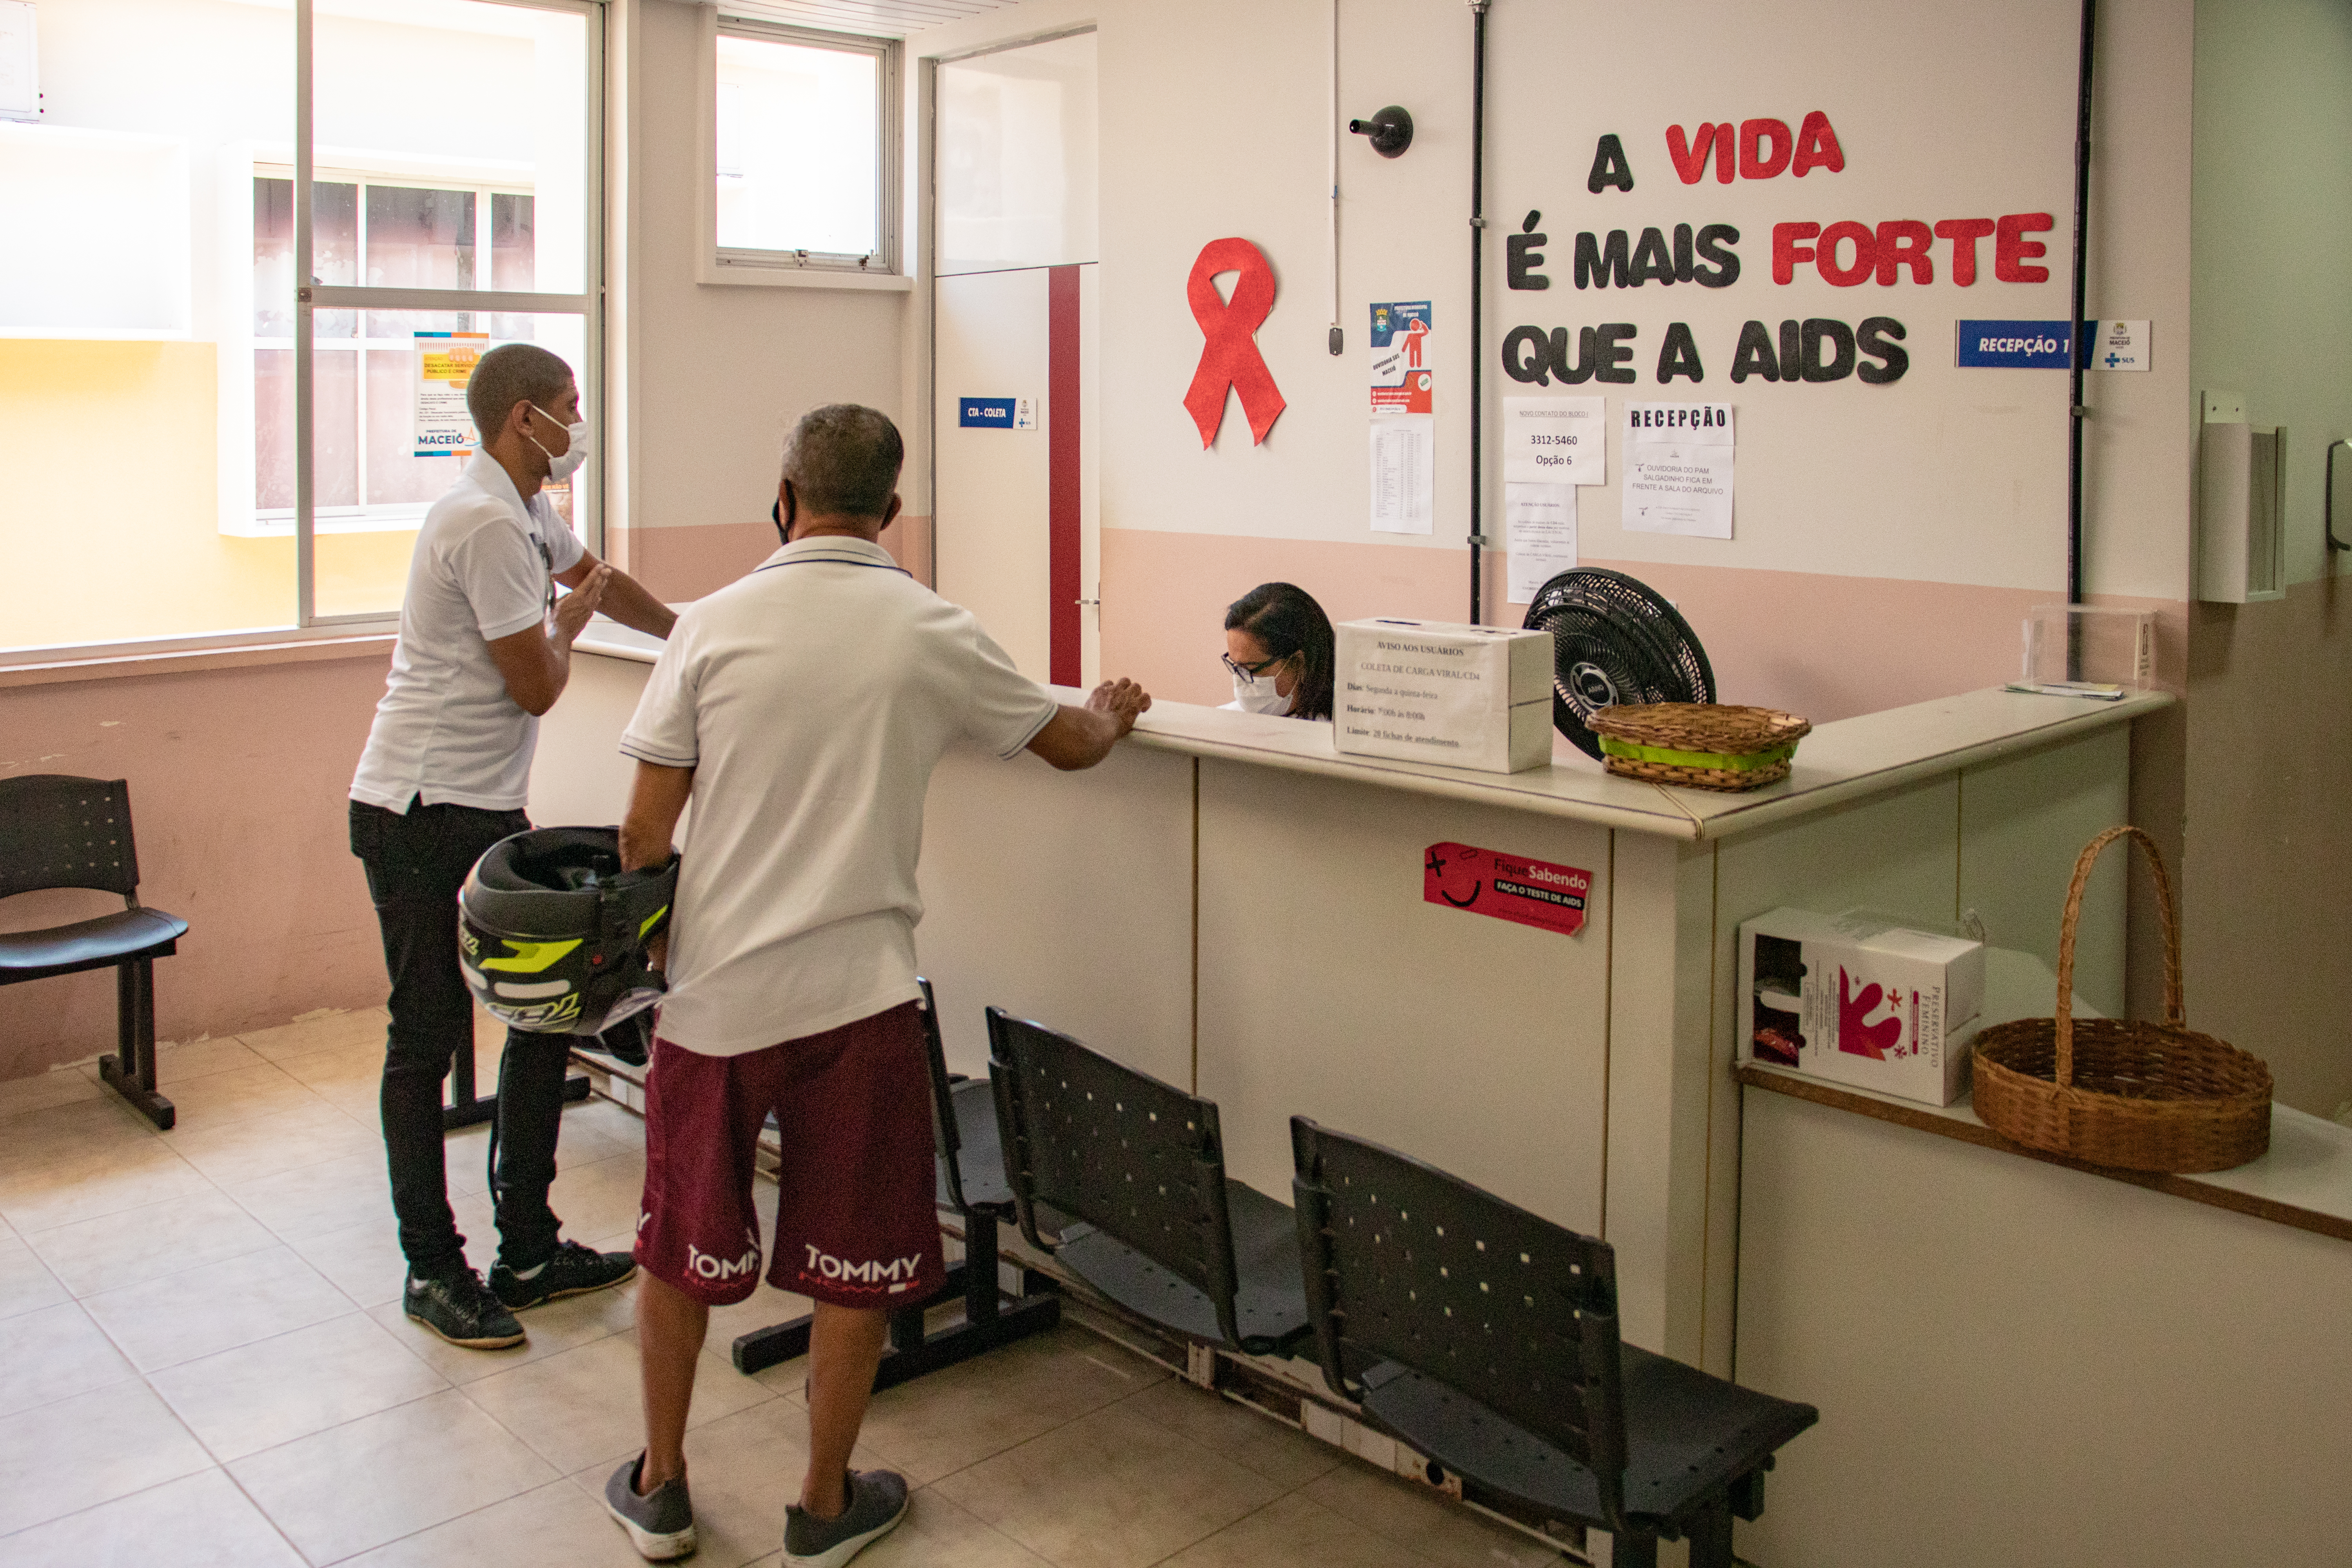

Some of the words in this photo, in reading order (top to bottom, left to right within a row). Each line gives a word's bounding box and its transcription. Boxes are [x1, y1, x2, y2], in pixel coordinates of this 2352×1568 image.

[1587, 133, 1633, 194] A
[1665, 110, 1845, 184] VIDA
[1506, 209, 1550, 290] É
[1573, 223, 1740, 290] MAIS
[1772, 212, 2054, 287] FORTE
[1501, 323, 1637, 387] QUE
[1656, 322, 1704, 384] A
[1730, 316, 1909, 385] AIDS
[1978, 335, 2057, 356] RECEPÇÃO
[2063, 339, 2070, 353] 1
[968, 407, 979, 417] CTA
[984, 407, 1006, 417] COLETA
[1631, 406, 1726, 430] RECEPÇÃO
[418, 433, 464, 445] MACEIÓ
[1531, 435, 1577, 445] 3312-5460
[1536, 455, 1564, 466] Opção
[1567, 456, 1572, 465] 6
[1644, 474, 1684, 482] SALGADINHO
[1377, 641, 1401, 650] AVISO
[1421, 644, 1464, 656] USUÁRIOS
[1361, 662, 1391, 672] COLETA
[1406, 667, 1435, 676] CARGA
[1494, 858, 1528, 877] Fique
[1529, 866, 1586, 890] Sabendo
[1497, 882, 1517, 893] FAÇA
[1527, 888, 1549, 900] TESTE
[1551, 894, 1561, 903] DE
[1563, 897, 1581, 907] AIDS
[1922, 995, 1931, 1055] FEMININO
[1932, 986, 1941, 1068] PRESERVATIVO
[806, 1243, 921, 1282] TOMMY
